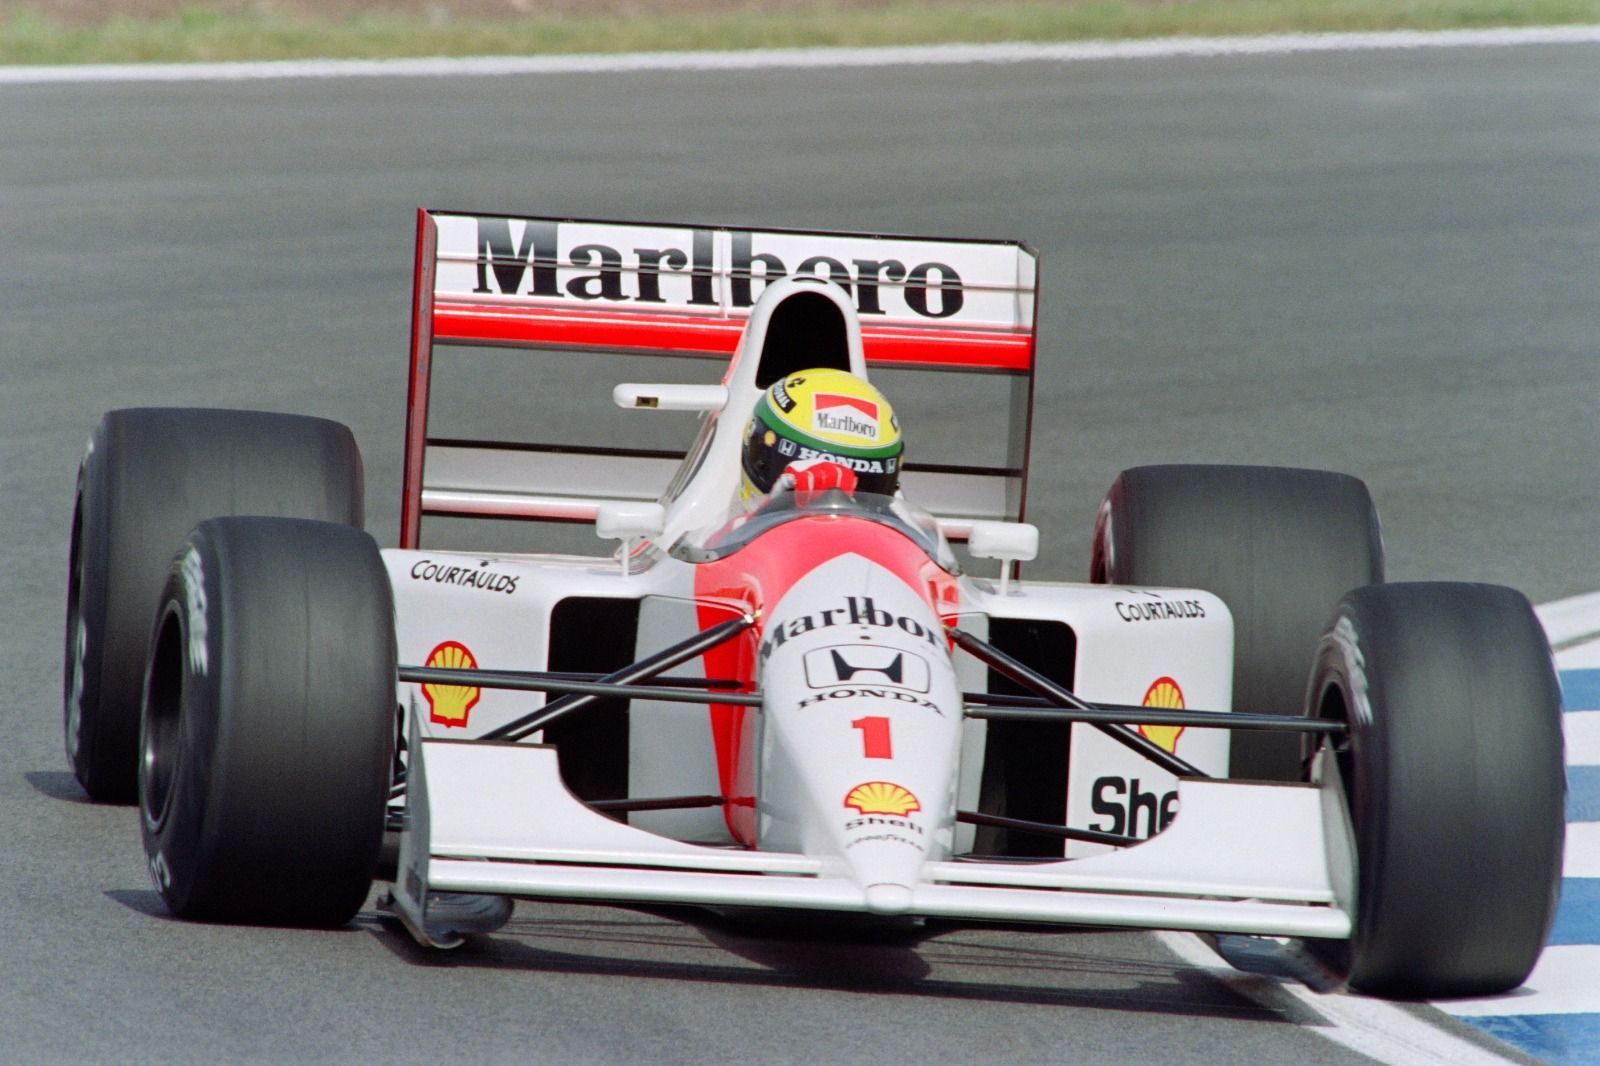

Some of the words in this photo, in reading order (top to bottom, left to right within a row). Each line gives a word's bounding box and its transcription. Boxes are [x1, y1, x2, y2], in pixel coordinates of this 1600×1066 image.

[817, 412, 876, 438] Marlboro
[411, 560, 520, 594] COURTAULDS
[1115, 600, 1206, 622] COURTAULDS
[760, 596, 947, 658] Marlbor
[797, 689, 946, 717] HONDA
[852, 716, 892, 759] 1
[844, 817, 923, 835] Shell
